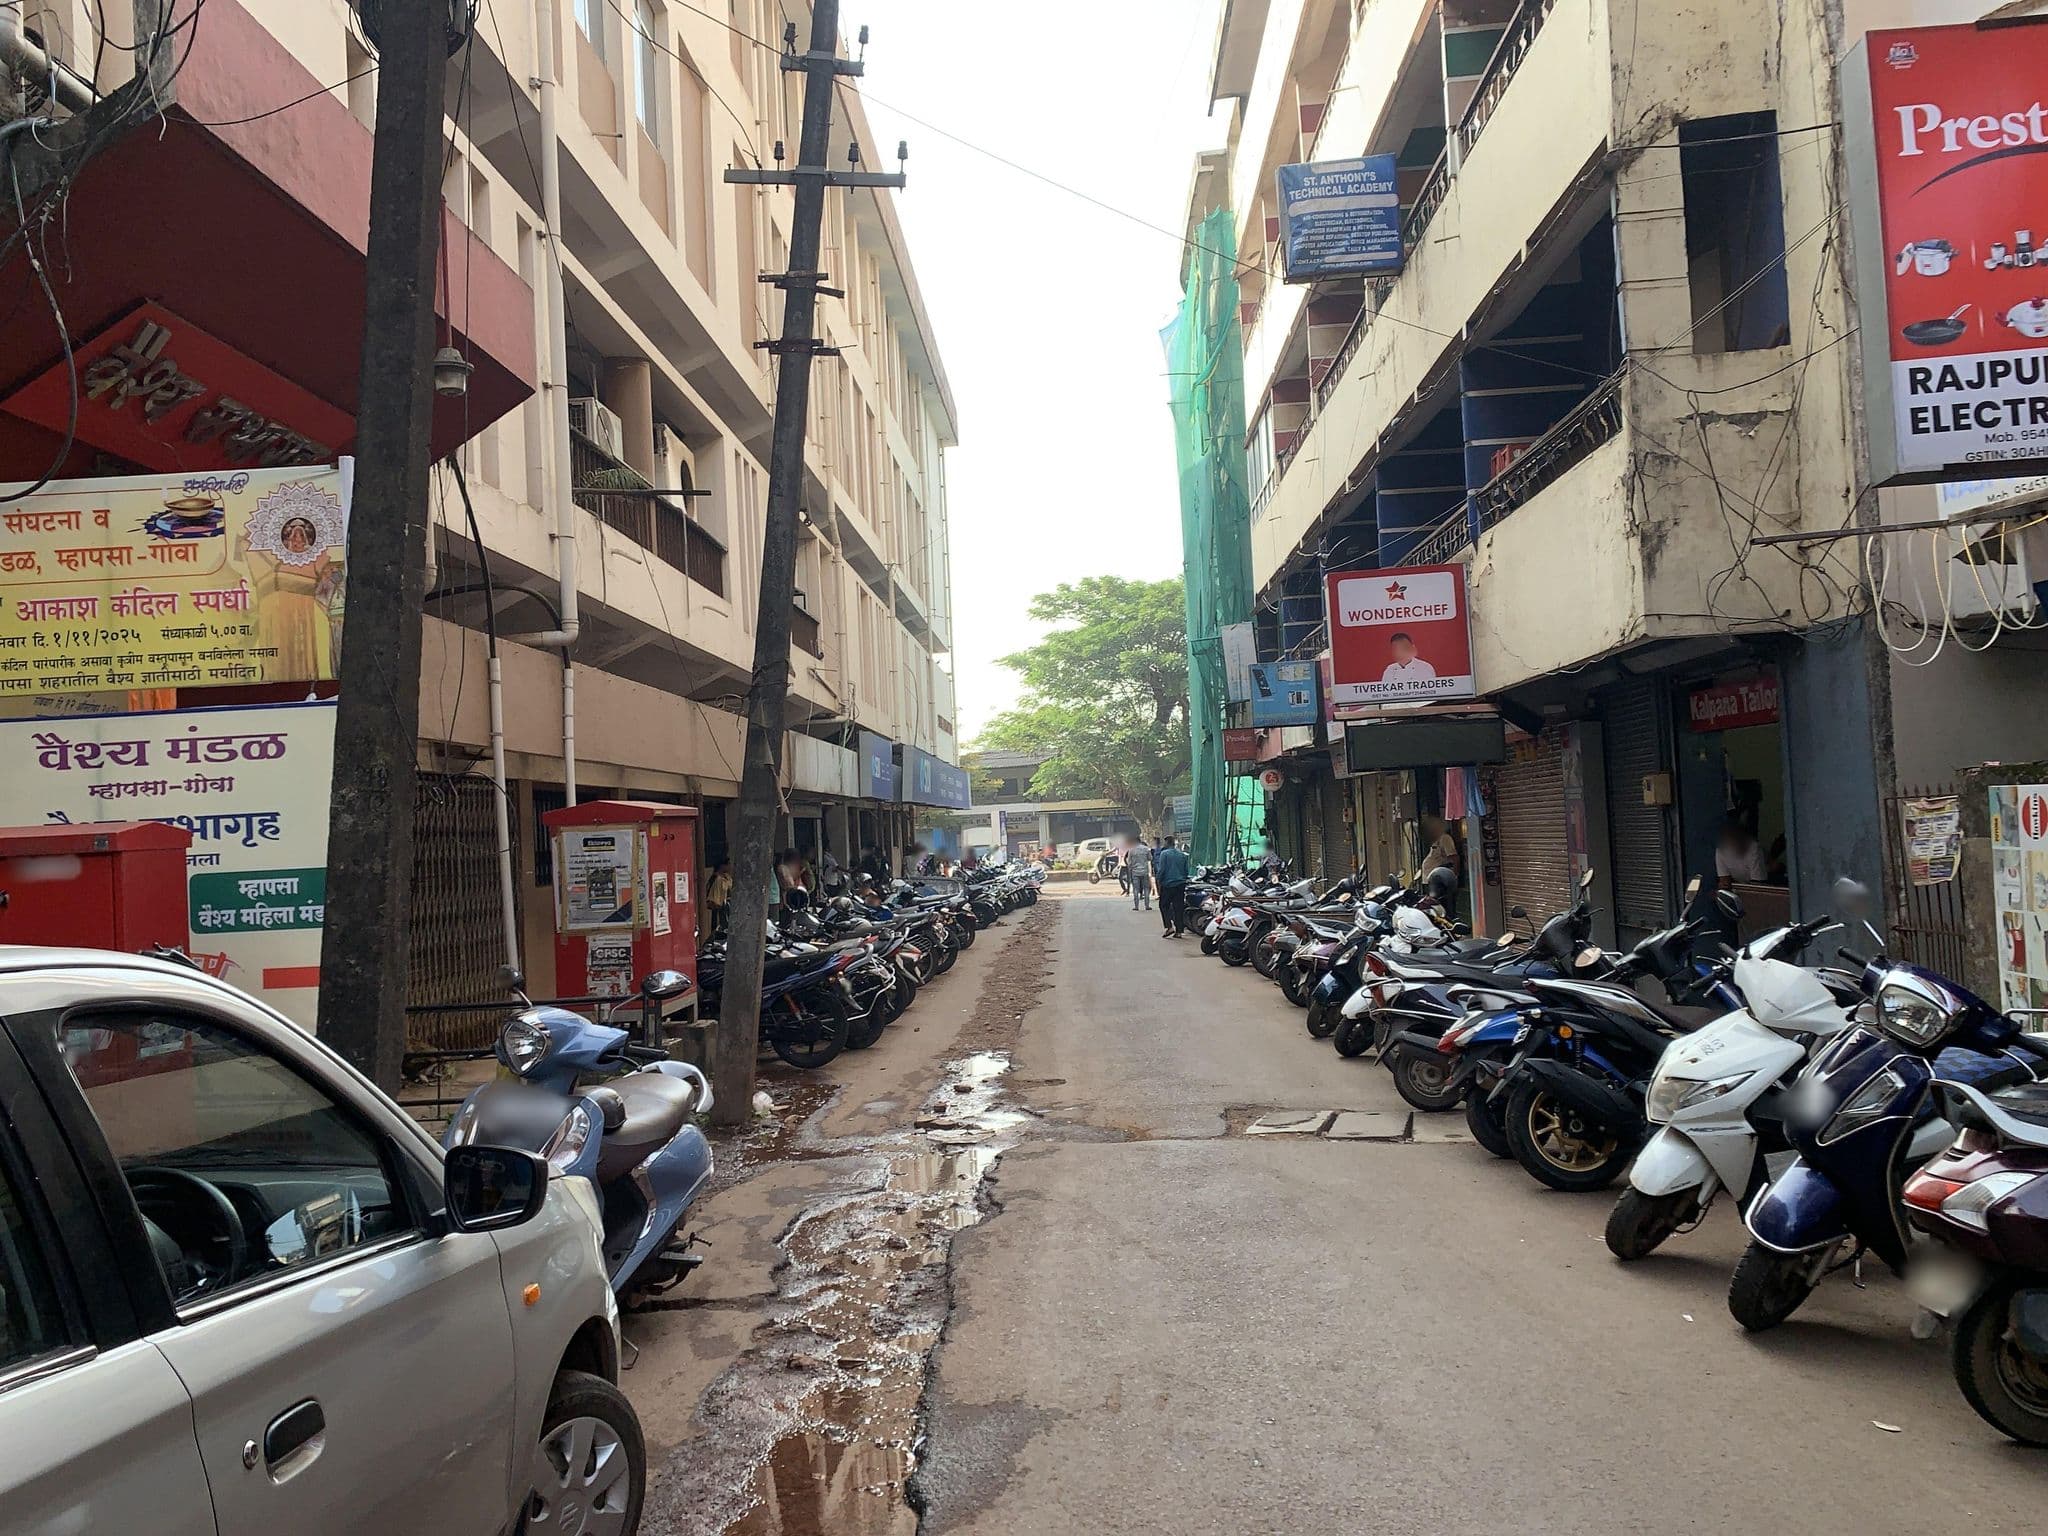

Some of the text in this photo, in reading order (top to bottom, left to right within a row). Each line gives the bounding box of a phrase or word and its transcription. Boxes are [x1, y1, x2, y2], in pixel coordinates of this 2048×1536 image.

[1893, 101, 2048, 157] Prest
[1289, 181, 1393, 201] TECHNICAL ACADEMY
[1303, 171, 1377, 187] ST. ANTHONY'S
[1908, 355, 2048, 395] RAJPU
[1910, 396, 2048, 435] ELECTR
[1985, 429, 2048, 443] Mob. 954
[1966, 450, 2008, 462] GSTIN:
[4, 508, 110, 535] संघटना व
[16, 578, 250, 622] आकाश कंदिल स्पर्धा
[1348, 603, 1449, 622] WONDERCHEF
[39, 671, 100, 690] शहरातील
[106, 668, 134, 685] वैश्य
[1352, 683, 1404, 694] TIVREKAR
[1406, 678, 1455, 690] TRADERS
[1690, 694, 1739, 725] Kalpana
[31, 725, 288, 771] वैश्य मंडळ
[138, 811, 281, 848] भागृह
[238, 877, 299, 901] म्हापसा
[198, 904, 236, 928] वैश्य
[240, 902, 294, 928] महिला
